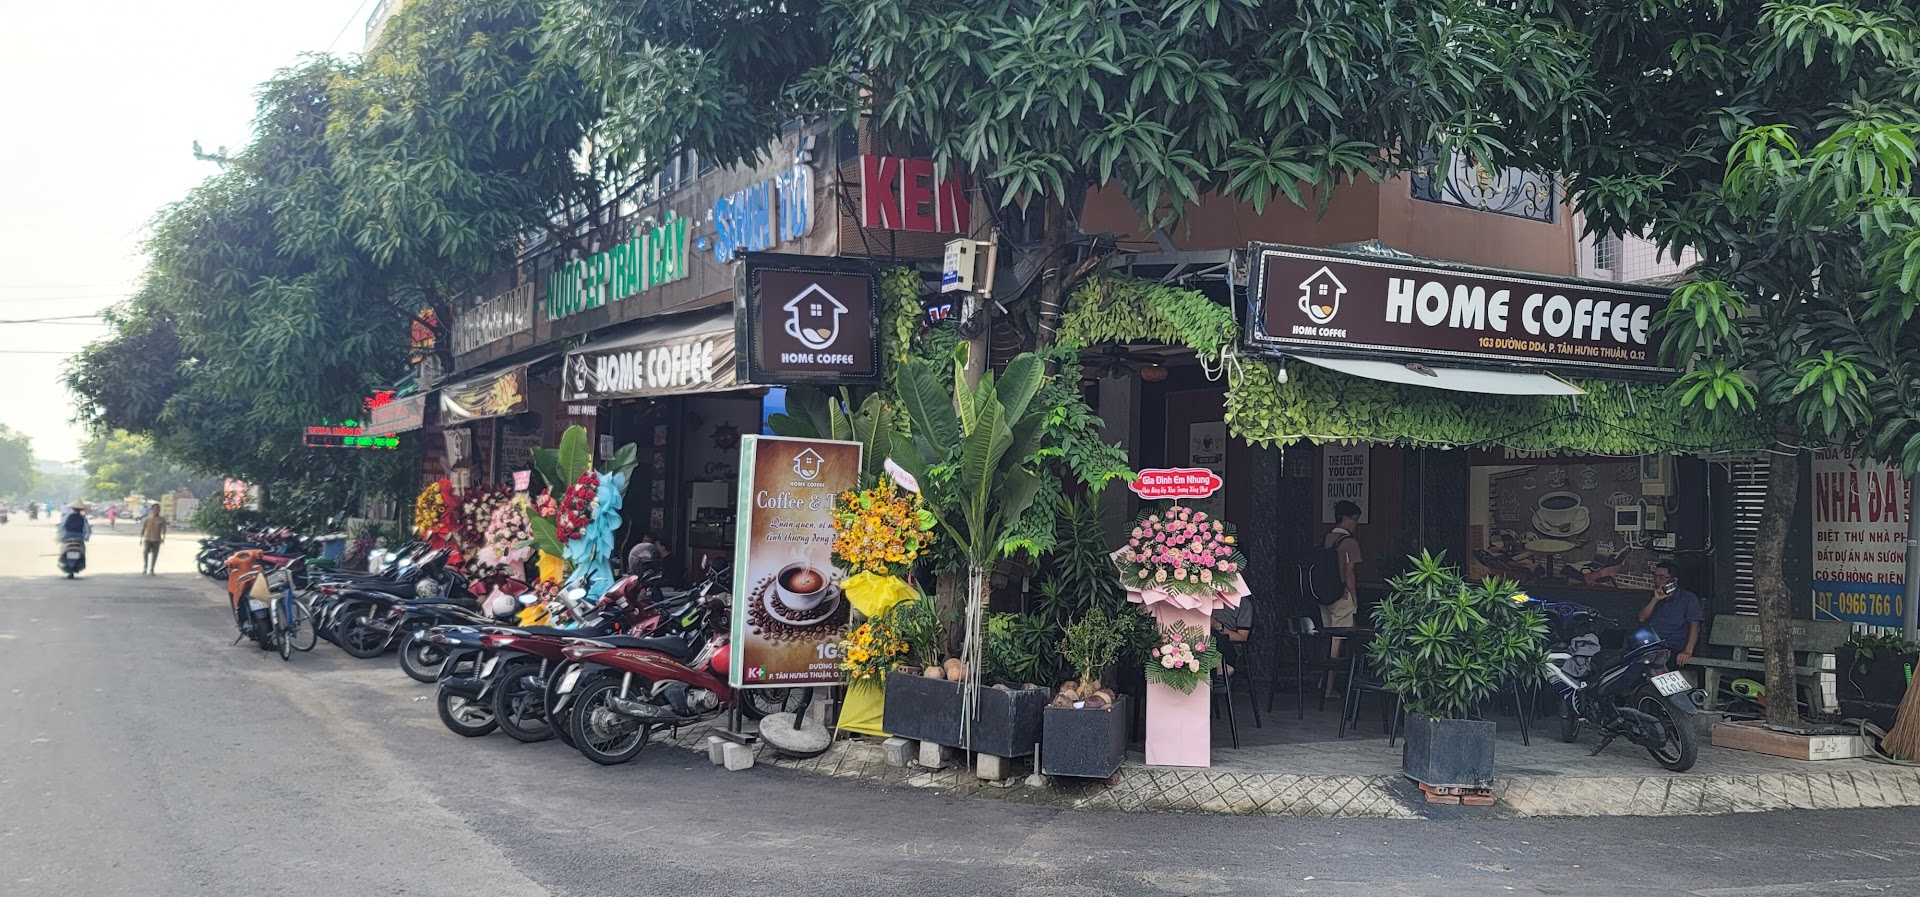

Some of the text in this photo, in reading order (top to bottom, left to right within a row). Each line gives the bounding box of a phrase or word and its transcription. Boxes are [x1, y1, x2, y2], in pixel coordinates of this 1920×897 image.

[609, 225, 650, 301] TRÁI
[650, 210, 693, 287] CÂY
[714, 180, 776, 264] SINH
[776, 135, 815, 243] TỐ
[1385, 278, 1650, 345] HOME COFFEE
[1292, 325, 1347, 338] HOME COFFEE
[1479, 337, 1646, 361] 1G3 ĐƯỜNG DD4, P. TÂN HƯNG THUẬN, Q.12
[597, 340, 714, 392] HOME COFFEE
[781, 353, 854, 364] HOME COFFEE
[568, 405, 597, 415] HOME COFFEE
[1329, 454, 1363, 466] THE FEELING
[1328, 467, 1363, 476] YOU GET
[1142, 476, 1155, 485] Gia
[1174, 475, 1185, 484] Em
[1187, 475, 1210, 485] Nhung
[1328, 482, 1363, 497] RUN OUT
[1816, 463, 1862, 522] NHÀ
[757, 490, 804, 509] Coffee
[809, 493, 821, 510] &
[1817, 529, 1839, 543] BIỆT
[1845, 530, 1865, 544] THỰ
[1869, 529, 1890, 543] NHÀ
[1893, 531, 1908, 543] PH
[1817, 545, 1907, 564] ĐẤT DỰ ÁN AN SƯƠN
[1815, 565, 1904, 584] CÓ SỔ HỒNG RIÊN
[1869, 593, 1891, 616] 766
[809, 662, 833, 670] ĐƯỜNG
[775, 671, 788, 680] TÂN
[790, 671, 808, 679] HƯNG
[1656, 672, 1681, 686] 77-G1
